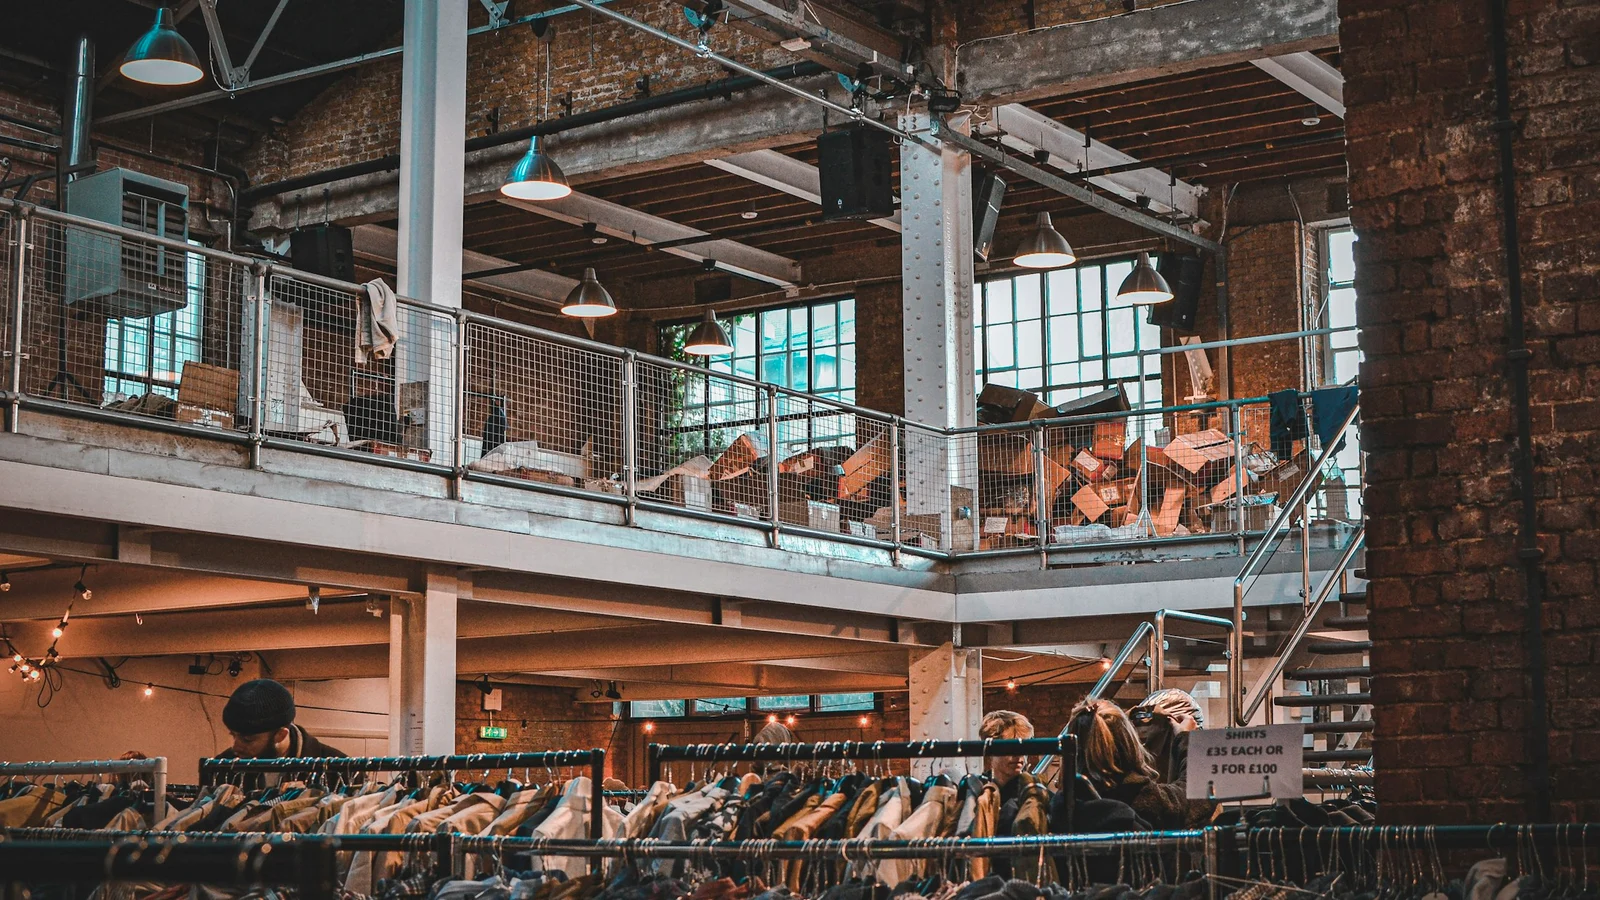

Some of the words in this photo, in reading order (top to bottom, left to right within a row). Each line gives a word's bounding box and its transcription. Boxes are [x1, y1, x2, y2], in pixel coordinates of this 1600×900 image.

[1225, 730, 1267, 740] SHIRTS
[1206, 746, 1228, 756] £35
[1231, 745, 1262, 756] EACH
[1265, 745, 1283, 755] OR
[1211, 764, 1218, 774] 3
[1221, 764, 1245, 774] FOR
[1249, 763, 1278, 774] £100
